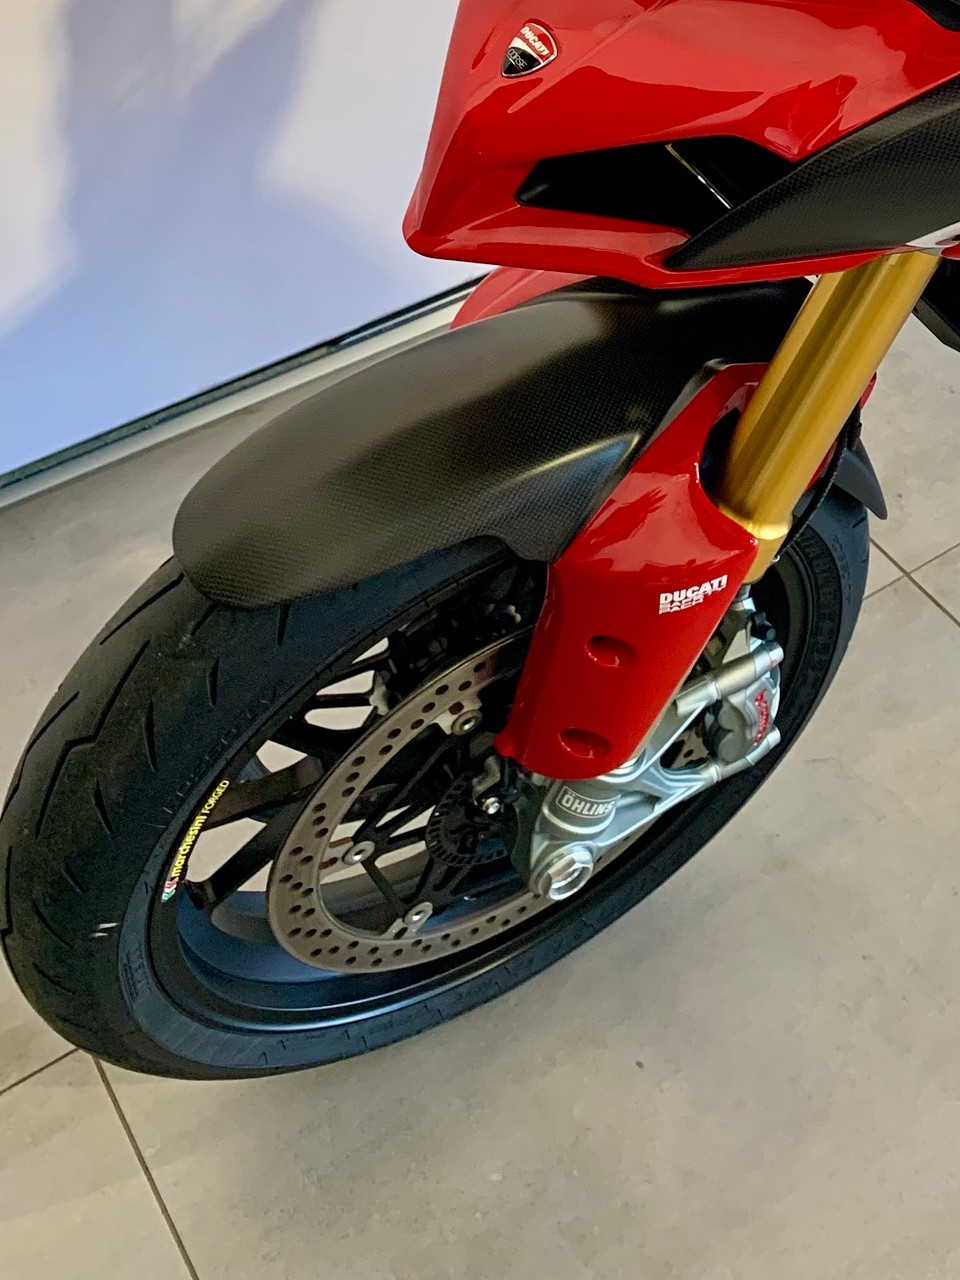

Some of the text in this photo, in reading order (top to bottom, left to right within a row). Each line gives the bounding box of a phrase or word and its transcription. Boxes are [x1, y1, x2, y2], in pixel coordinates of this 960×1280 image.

[520, 25, 551, 56] DUCATI
[507, 48, 528, 70] CORSE
[659, 574, 728, 604] DUCATI
[561, 789, 616, 816] ÖHLINS
[171, 779, 230, 877] marchesini FORGED
